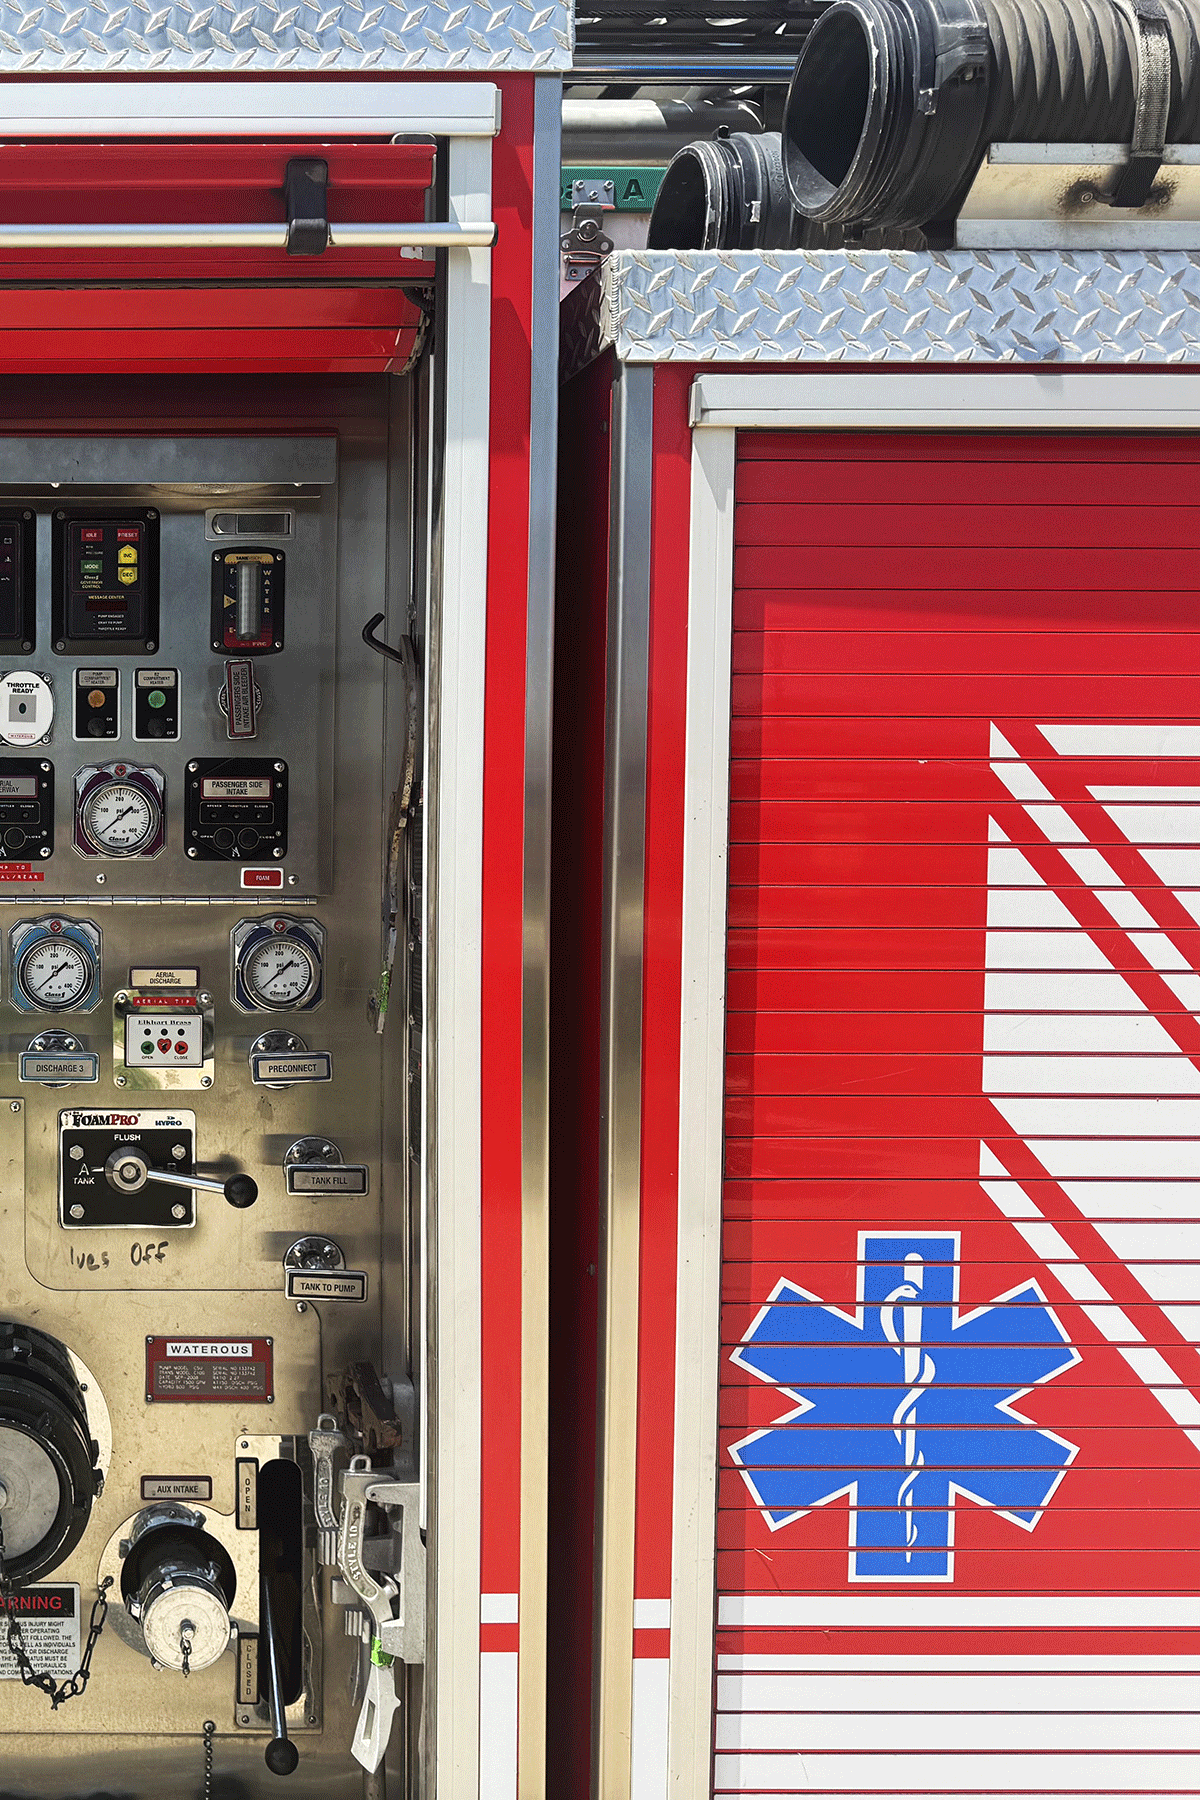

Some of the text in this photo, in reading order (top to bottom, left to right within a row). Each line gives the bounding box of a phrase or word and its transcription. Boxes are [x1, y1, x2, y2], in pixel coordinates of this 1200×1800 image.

[263, 570, 272, 613] WATER
[268, 1064, 317, 1073] PRECONNECT
[79, 1163, 90, 1175] A
[333, 1177, 348, 1185] FILL
[301, 1282, 320, 1291] TANK
[334, 1284, 356, 1293] PUMP
[171, 1346, 249, 1354] WATEROUS
